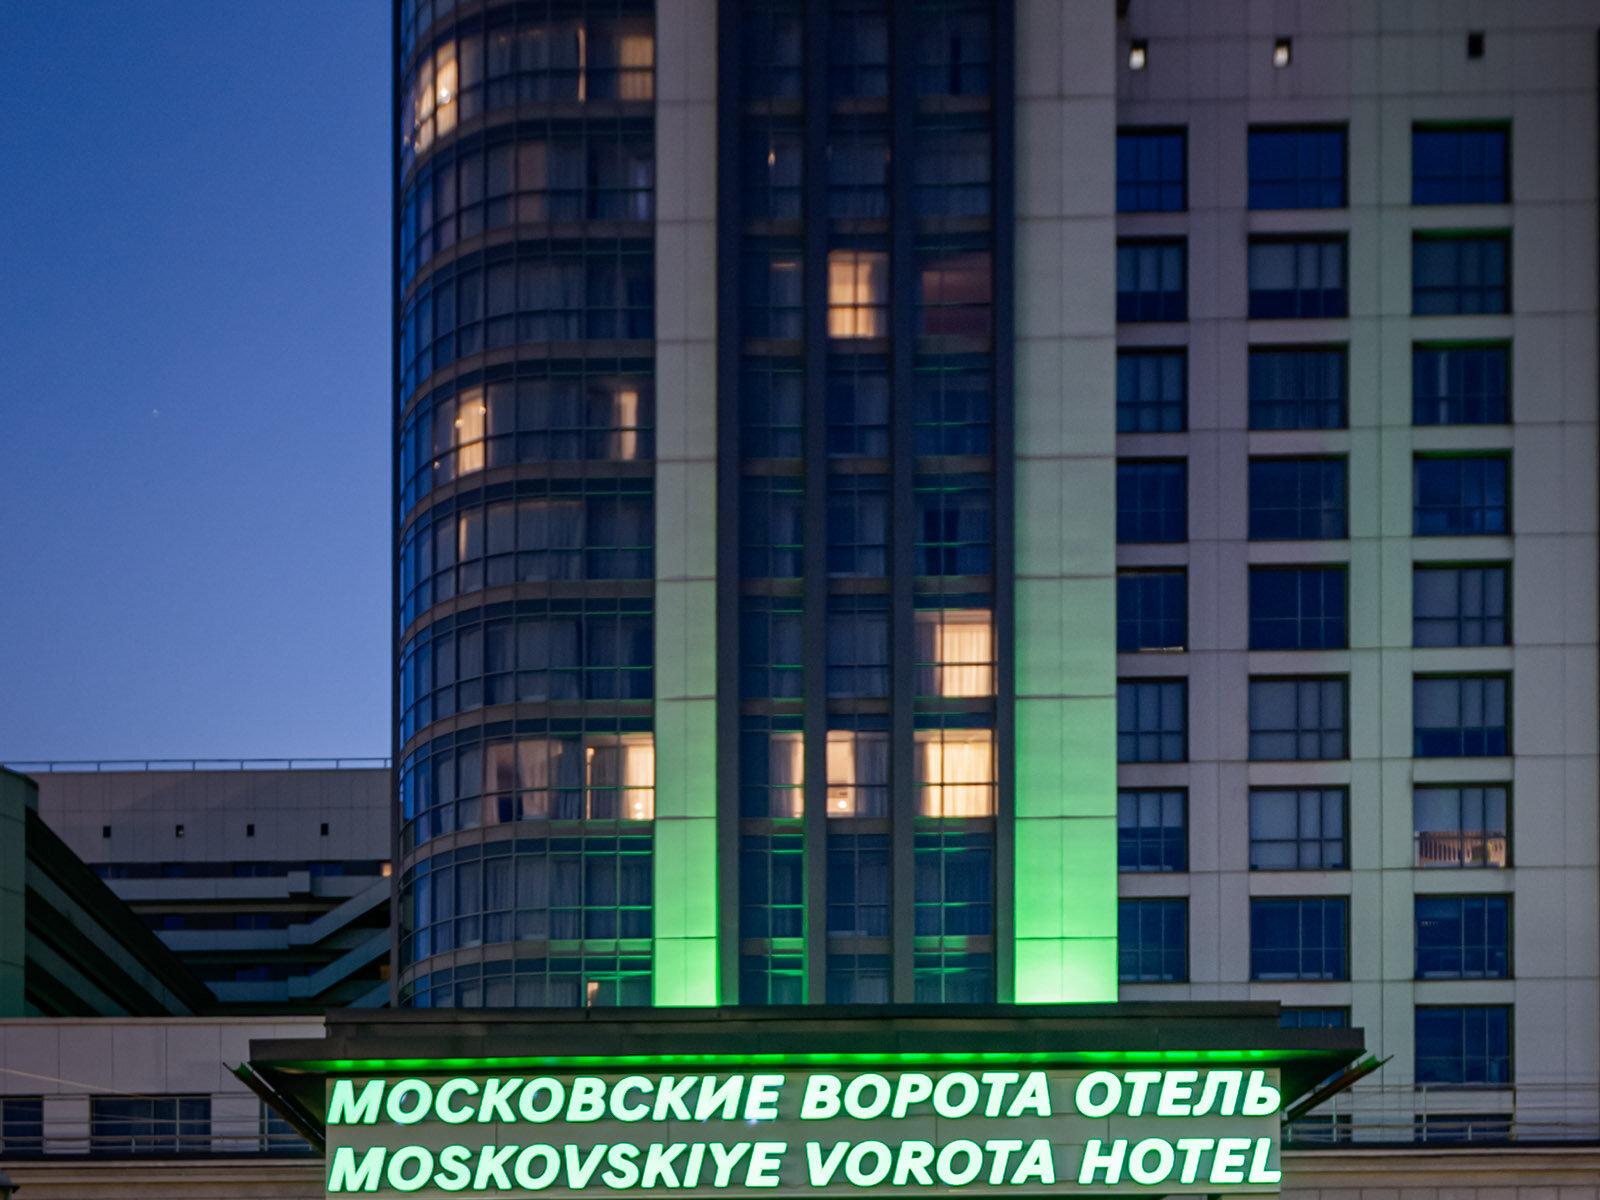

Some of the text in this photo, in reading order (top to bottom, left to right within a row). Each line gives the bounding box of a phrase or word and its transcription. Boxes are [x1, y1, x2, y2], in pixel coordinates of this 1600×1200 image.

[327, 1070, 1281, 1124] МОСКОВСКИЕ ВОРОТА ОТЕЛЬ
[328, 1137, 1282, 1191] MOSKOVSKIYE VOROTA HOTEL
